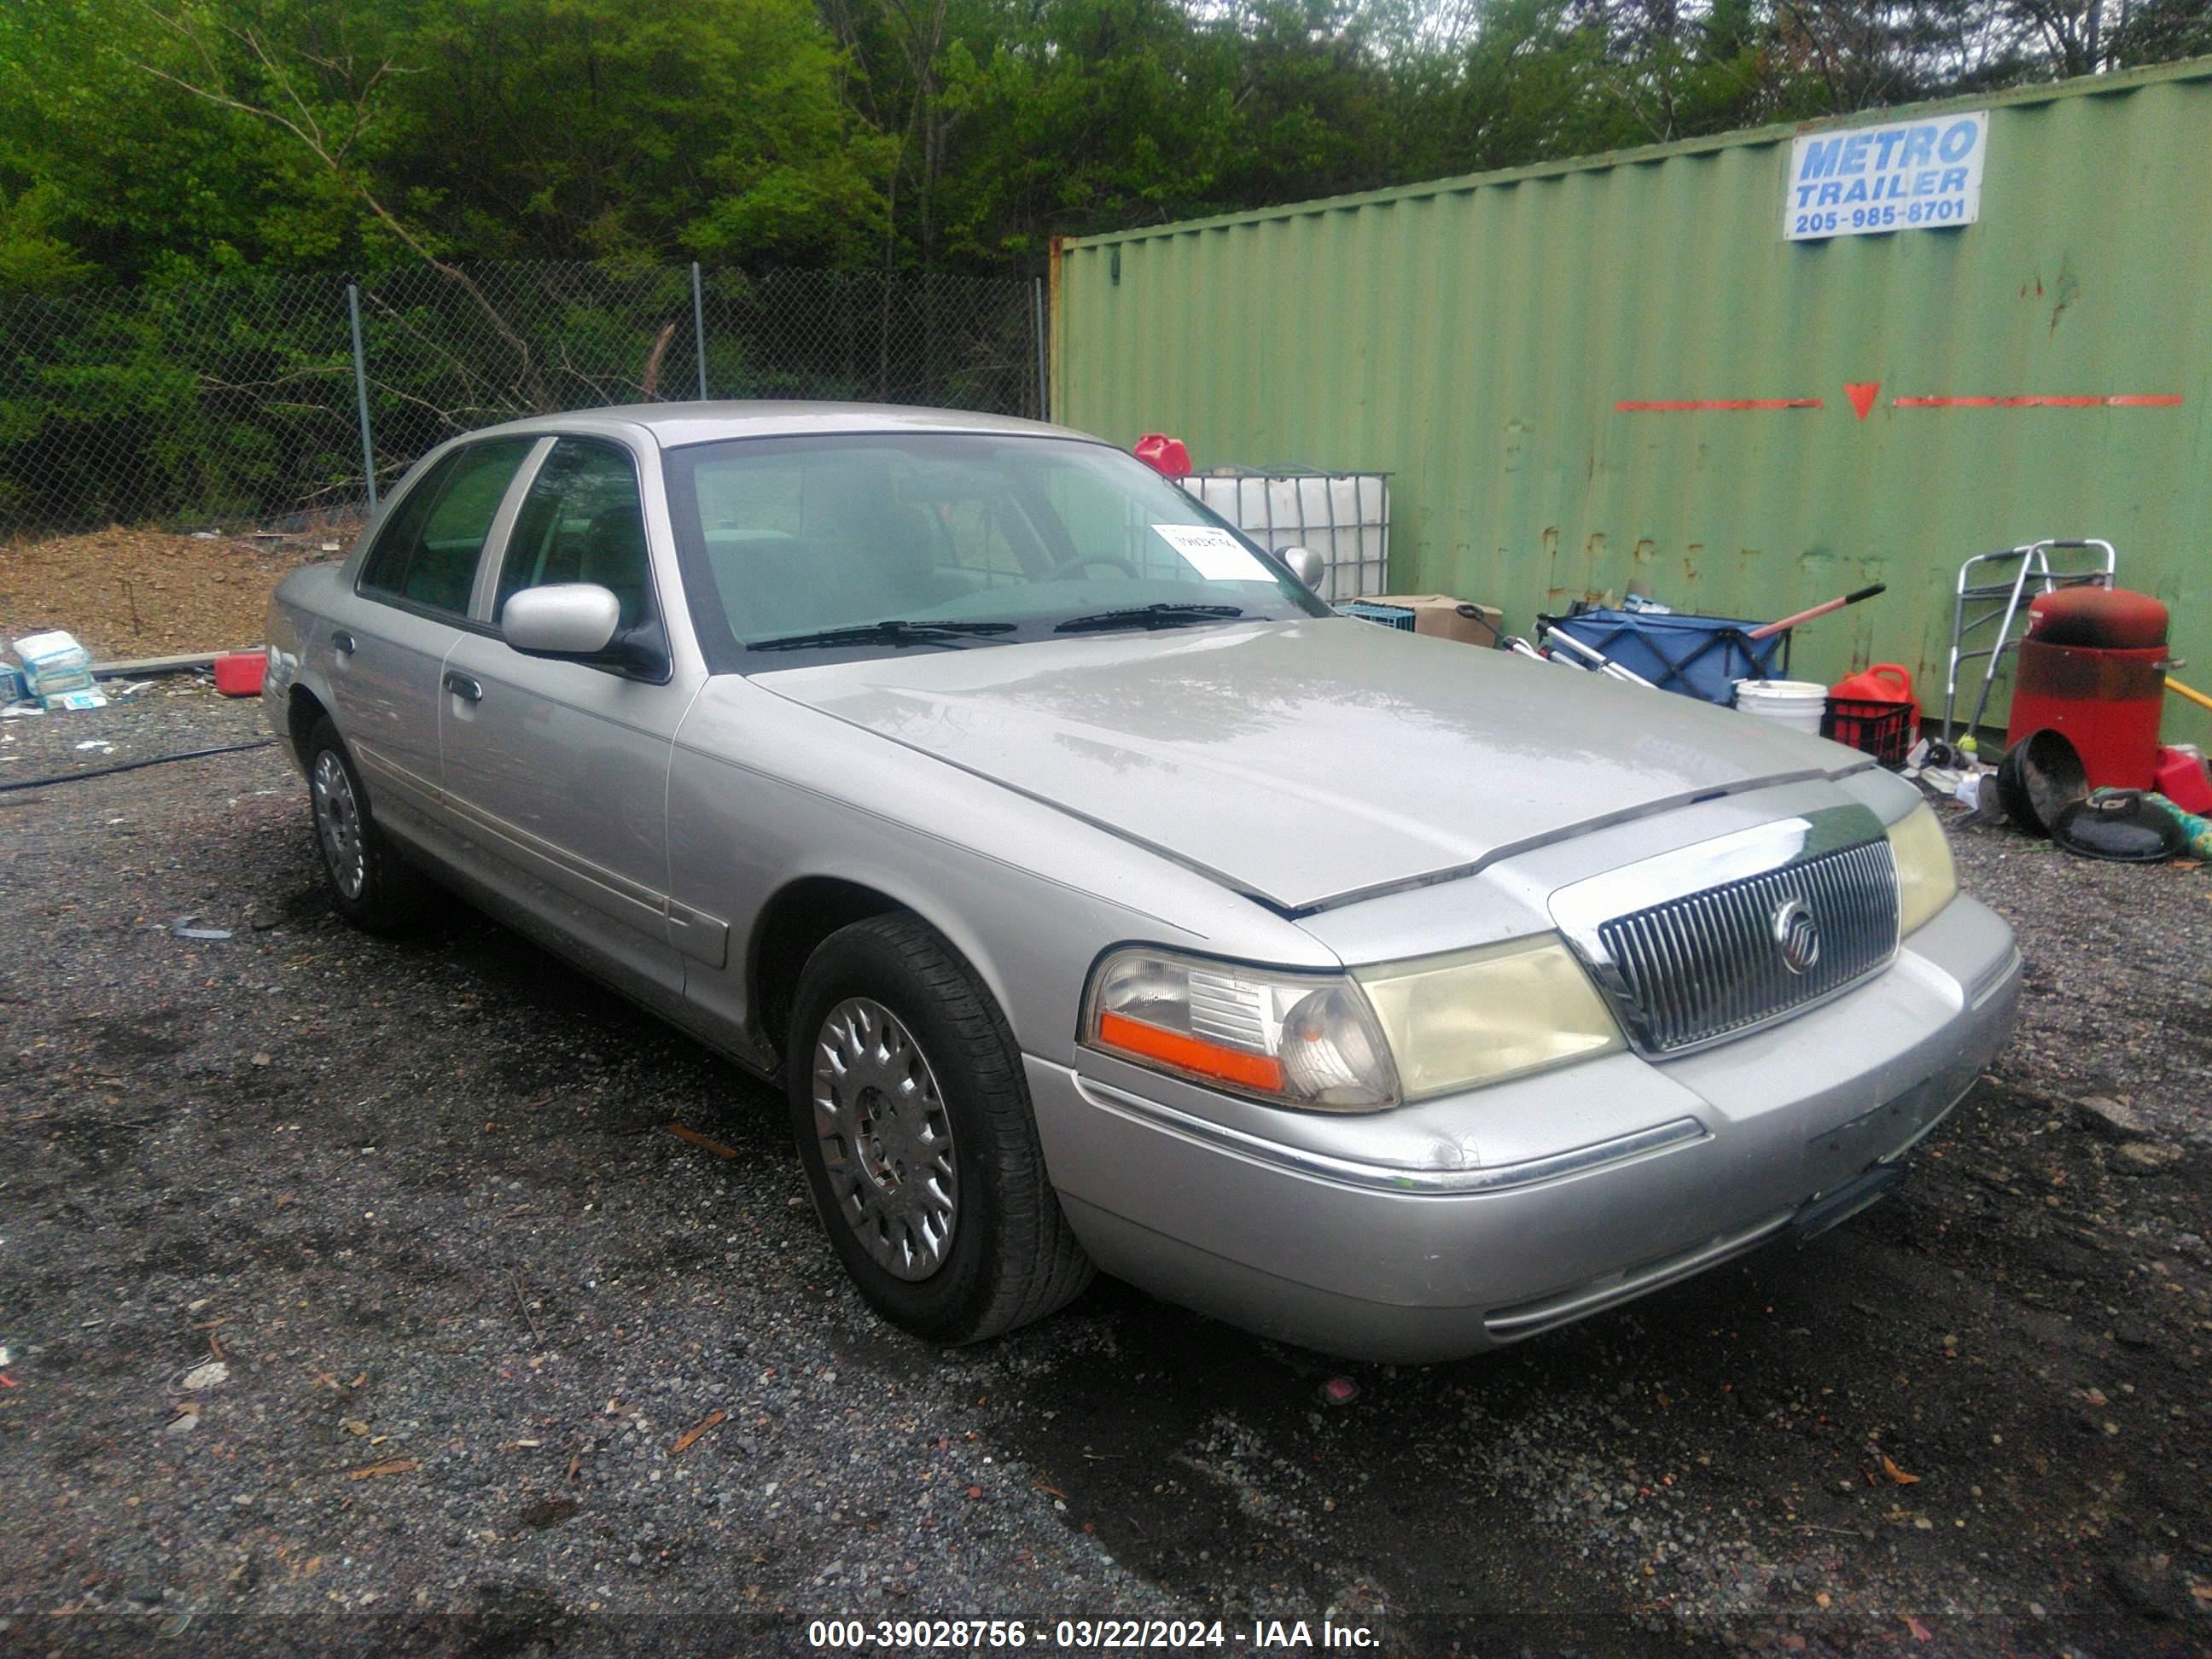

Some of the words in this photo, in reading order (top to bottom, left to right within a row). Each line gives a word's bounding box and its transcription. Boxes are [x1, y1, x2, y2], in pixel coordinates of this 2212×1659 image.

[1799, 119, 1979, 181] METRO
[1796, 166, 1970, 208] TRAILER
[1796, 198, 1965, 234] 205-985-8701
